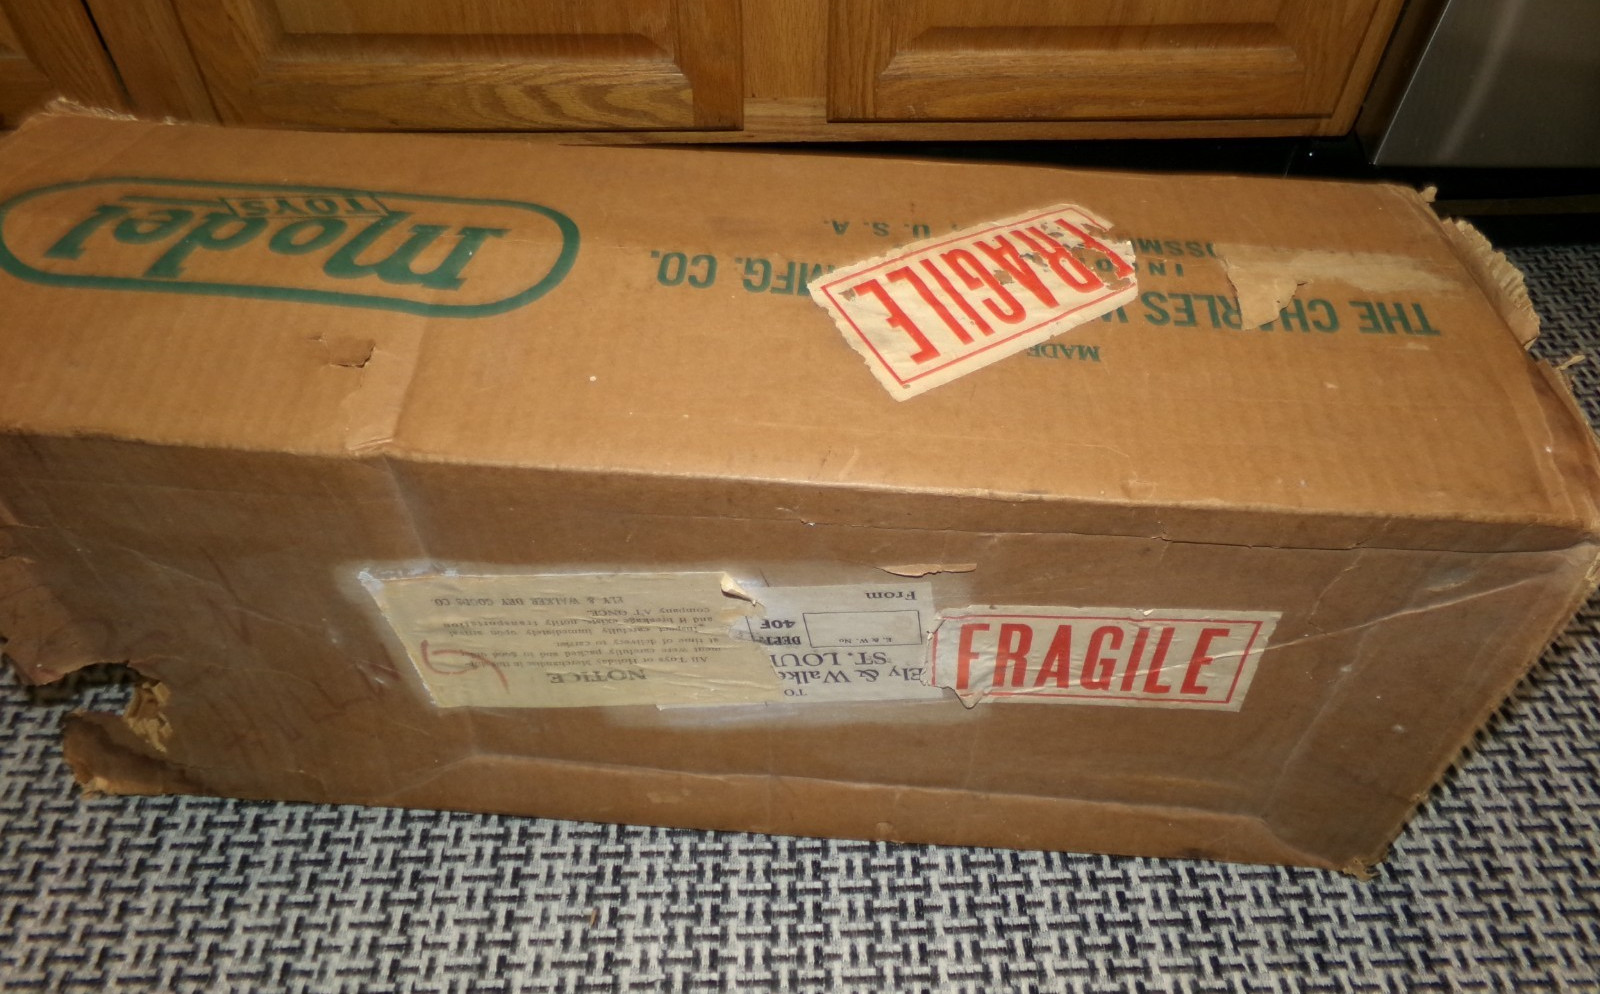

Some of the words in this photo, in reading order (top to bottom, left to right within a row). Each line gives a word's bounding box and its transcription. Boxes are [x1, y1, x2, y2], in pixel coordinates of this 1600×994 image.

[232, 194, 376, 217] TOYS
[650, 250, 718, 289] CO.
[853, 218, 1135, 365] FRAGILE
[1141, 291, 1340, 334] CHRLES
[1359, 300, 1441, 336] THE
[1027, 343, 1100, 362] MADE
[531, 597, 580, 605] WALKER
[602, 596, 624, 604] ELY
[865, 590, 917, 600] From
[456, 598, 493, 606] GOODS
[502, 598, 524, 606] DRY
[443, 620, 538, 628] transportation
[545, 619, 578, 627] notify
[760, 618, 797, 630] 40F
[526, 628, 592, 636] immediately
[602, 627, 651, 635] carefully
[614, 638, 657, 646] delivery
[565, 650, 602, 658] packed
[769, 652, 839, 667] LOUI
[847, 651, 887, 666] ST.
[955, 623, 1231, 695] FRAGILE
[547, 669, 648, 684] NOTICE
[777, 670, 852, 685] Walke
[853, 669, 880, 683] &
[889, 666, 924, 681] Ely
[783, 688, 807, 697] TO
